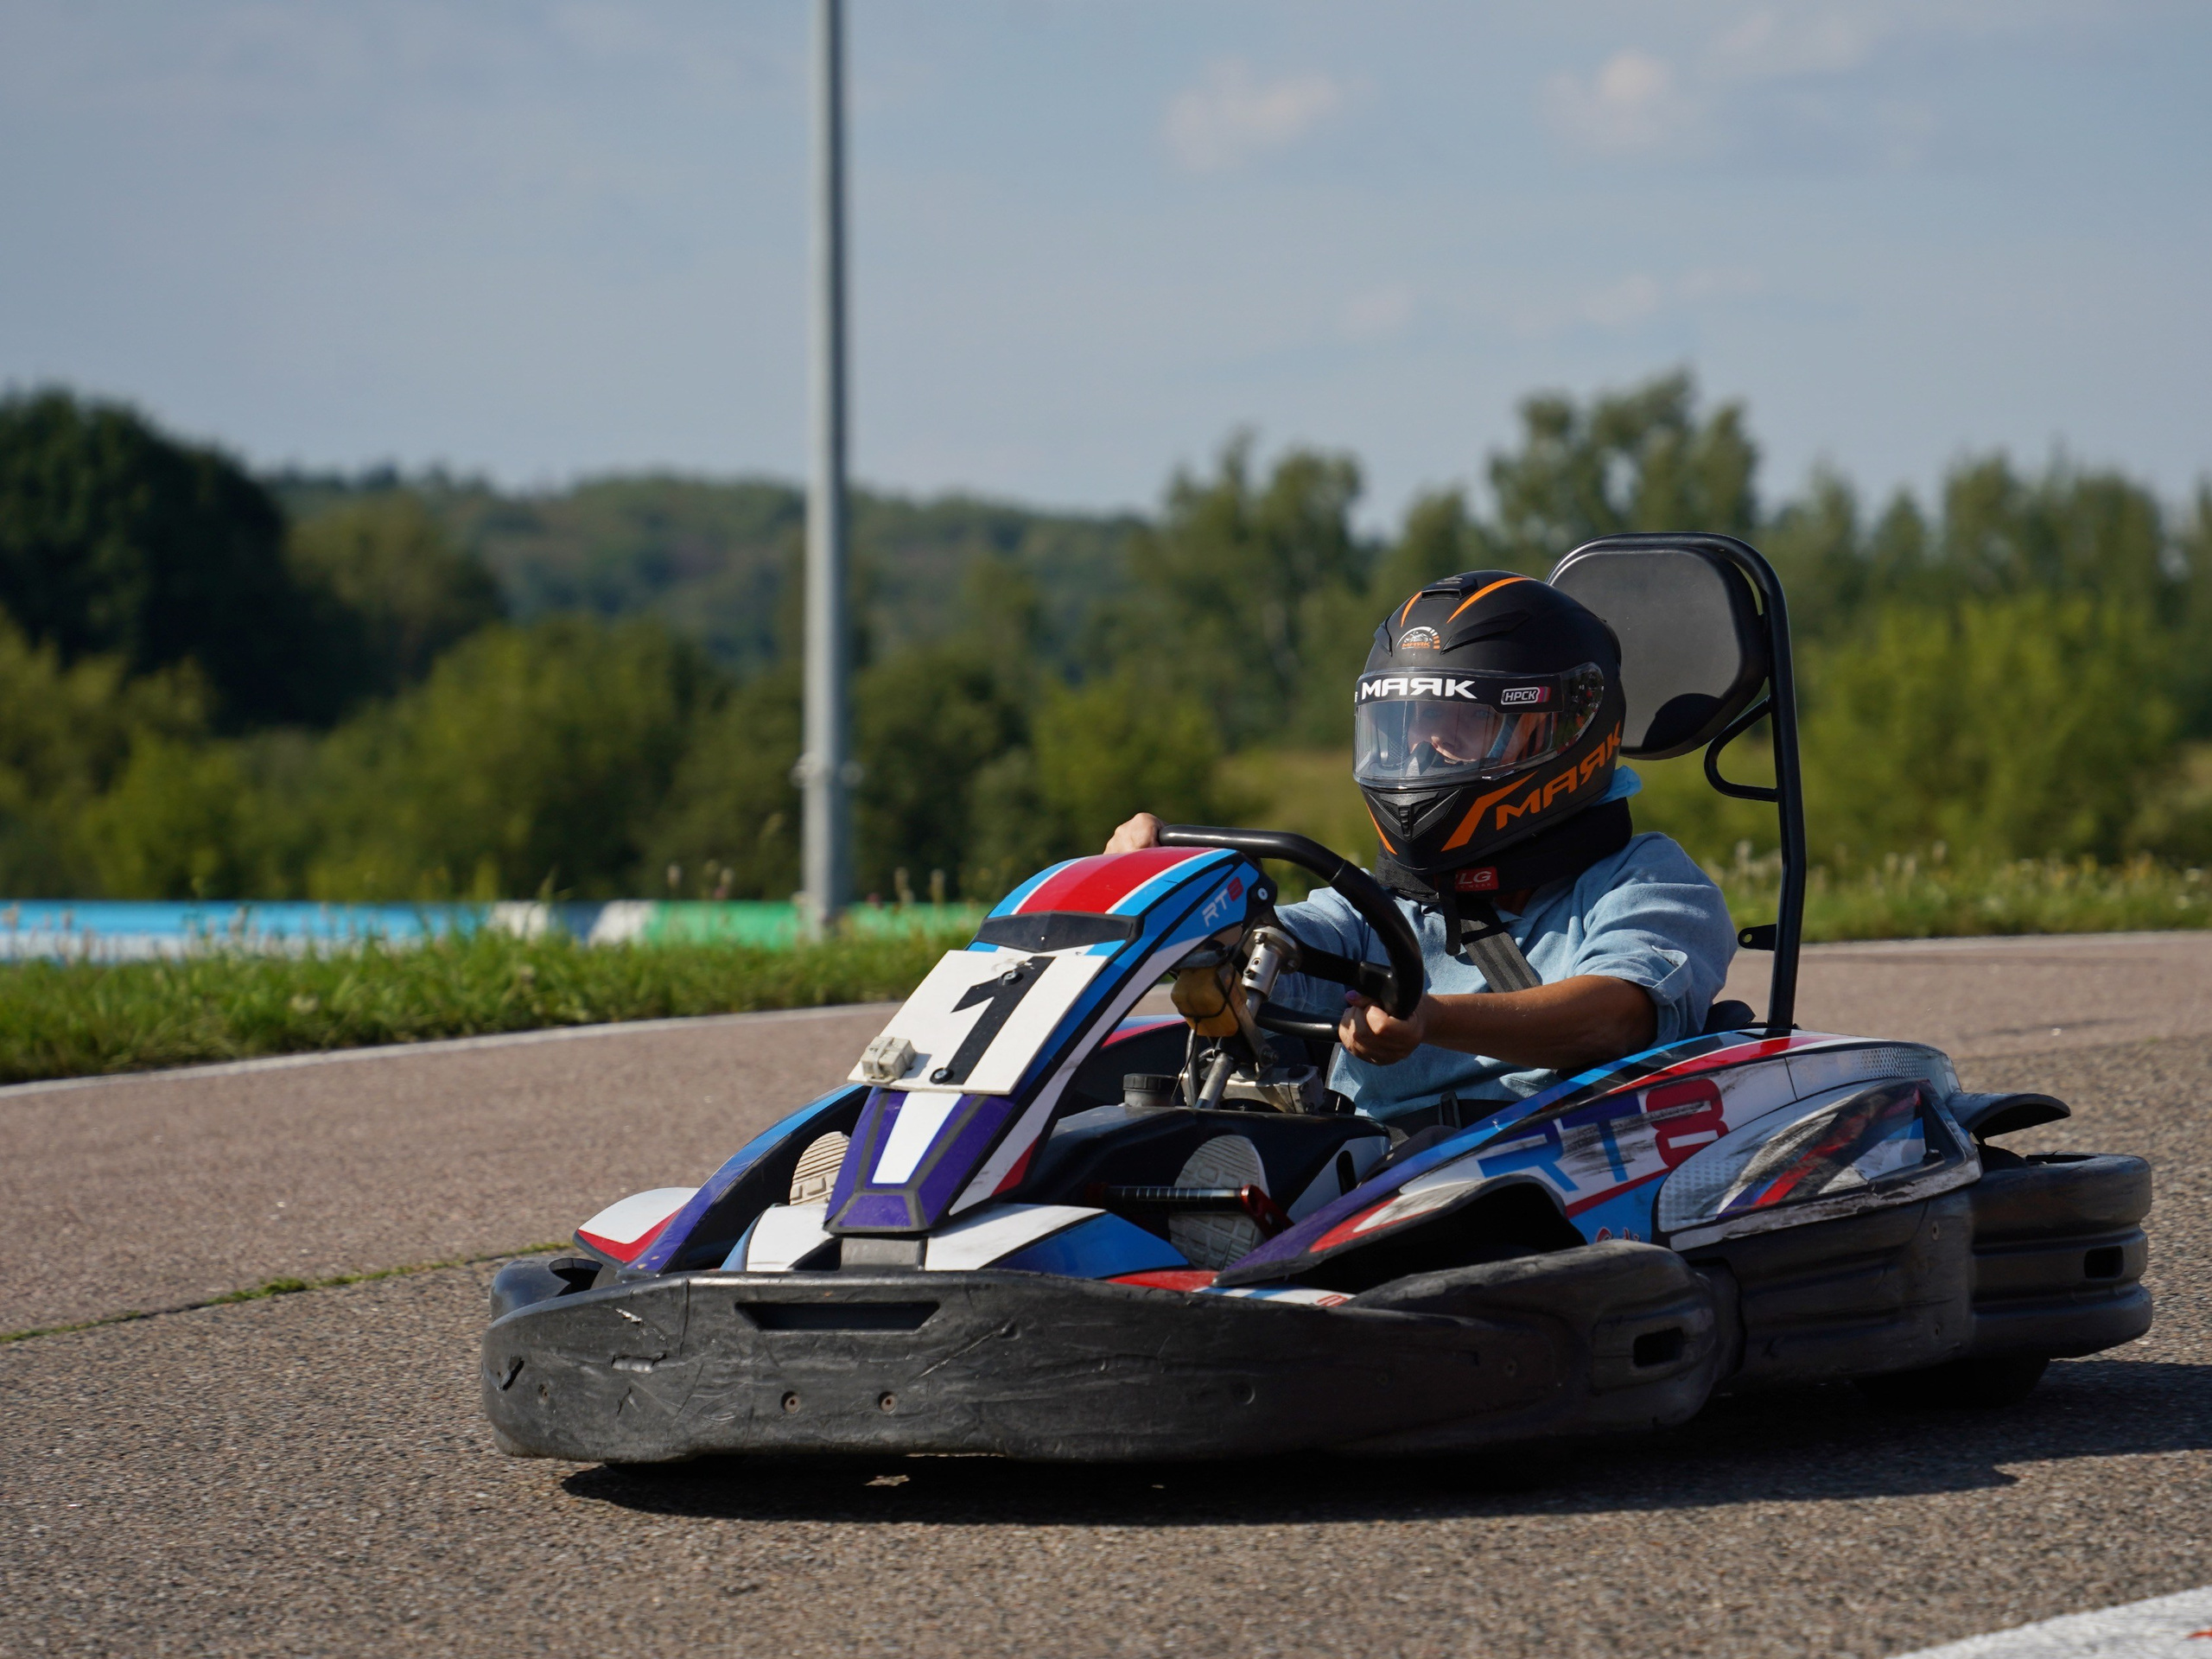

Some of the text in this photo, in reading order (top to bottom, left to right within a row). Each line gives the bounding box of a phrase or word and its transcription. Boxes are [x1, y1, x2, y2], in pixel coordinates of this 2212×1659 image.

[1361, 677, 1478, 700] МАЯК
[1202, 876, 1244, 927] RT8
[943, 956, 1058, 1085] 1
[1477, 1077, 1729, 1192] RT8
